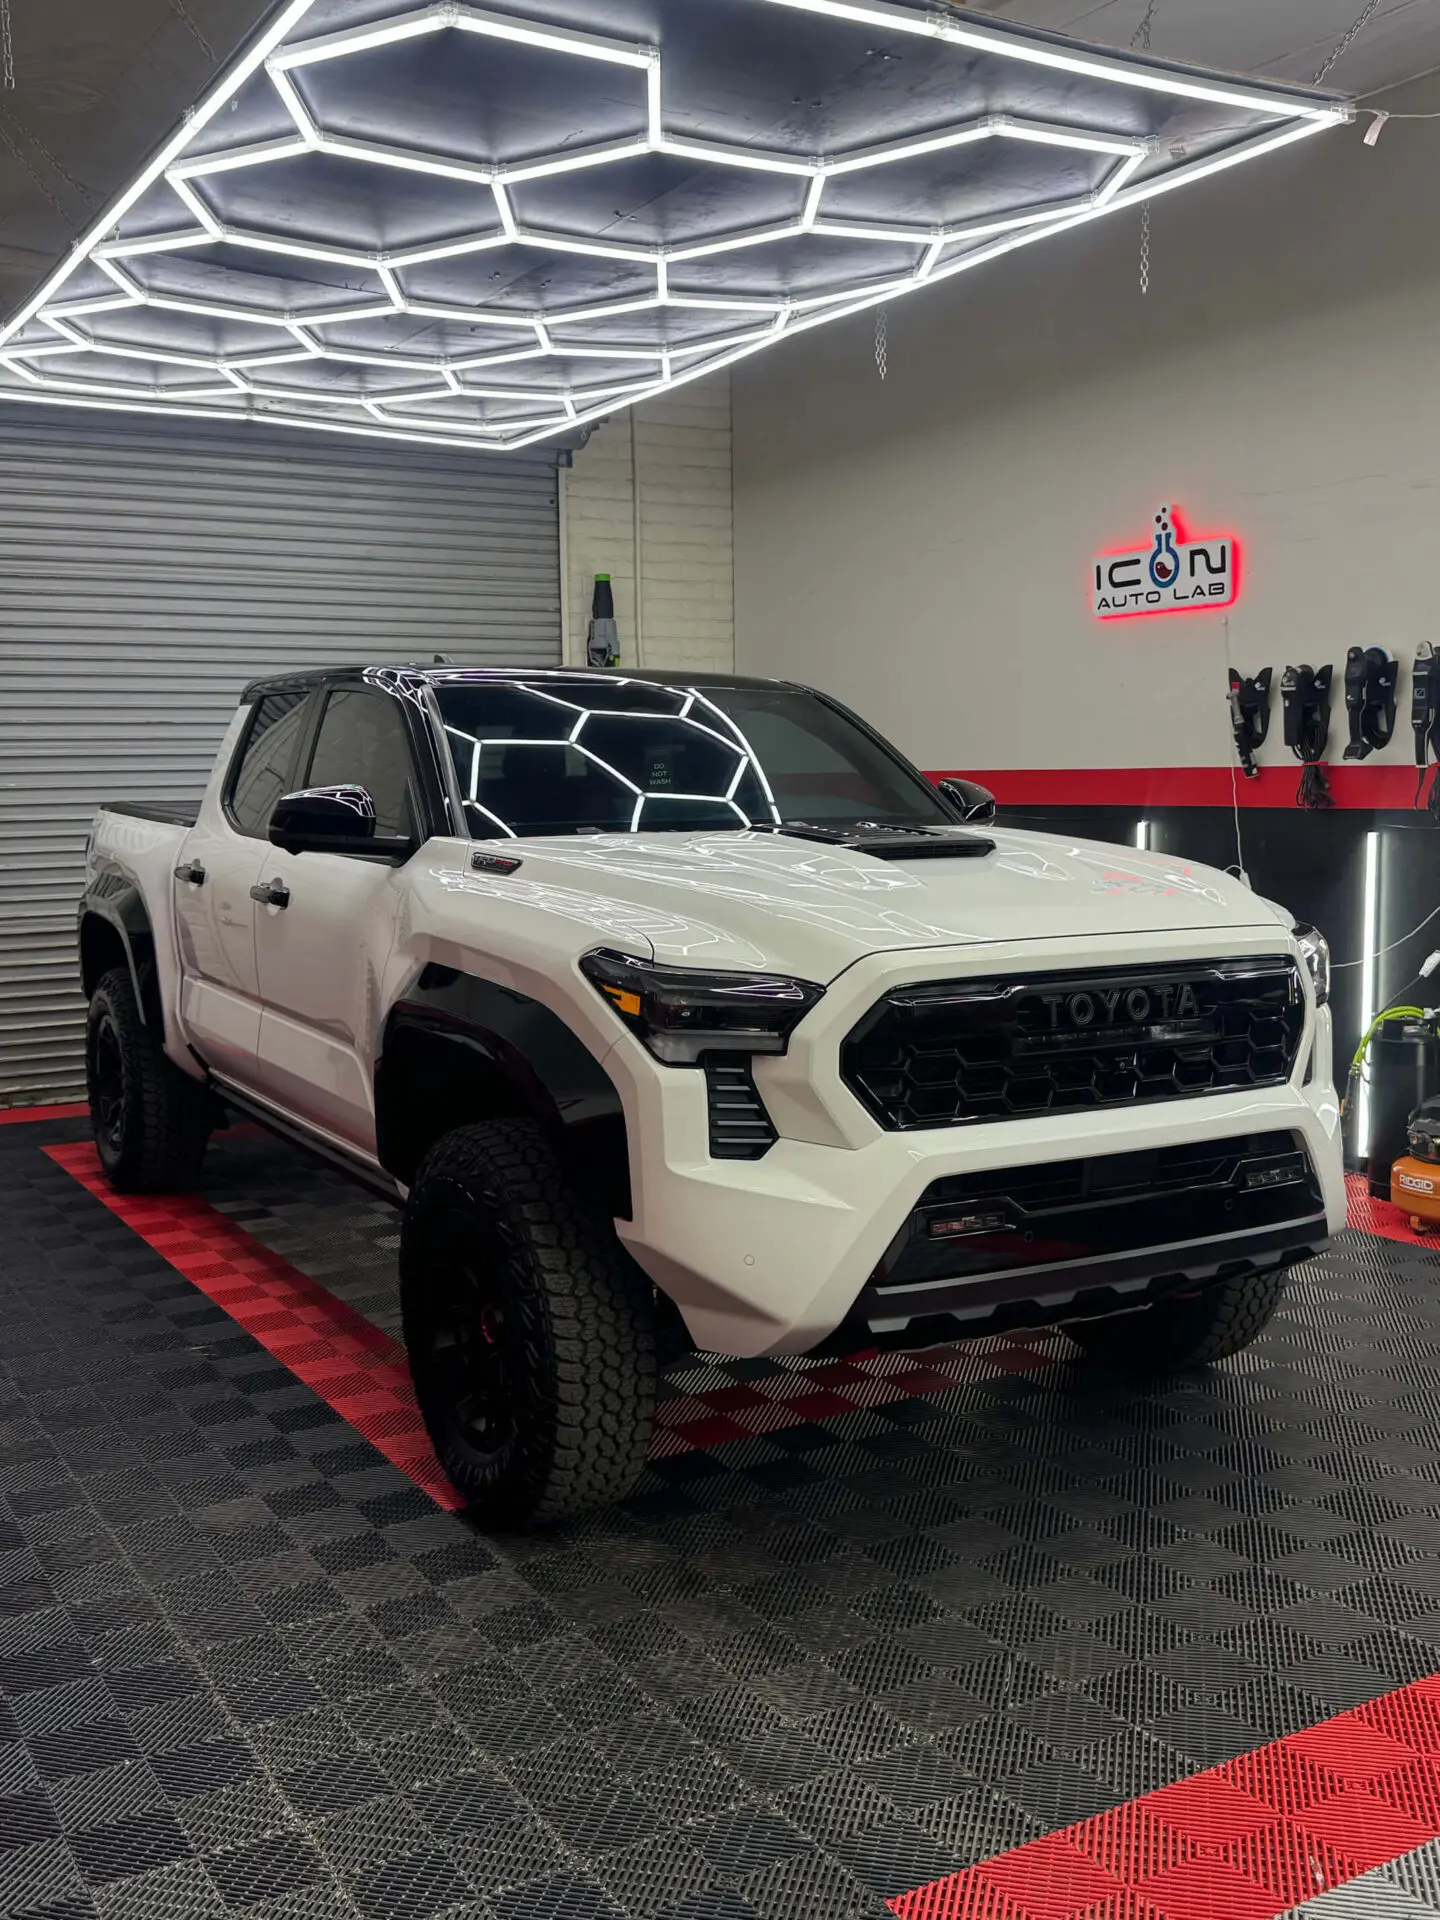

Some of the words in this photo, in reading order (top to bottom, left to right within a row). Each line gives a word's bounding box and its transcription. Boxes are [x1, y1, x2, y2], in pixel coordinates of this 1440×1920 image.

[1096, 541, 1226, 590] ICON
[1097, 591, 1161, 610] AUTO
[1173, 582, 1225, 600] LAB
[1042, 983, 1199, 1026] TOYOTA
[1399, 1174, 1434, 1191] RIDGID
